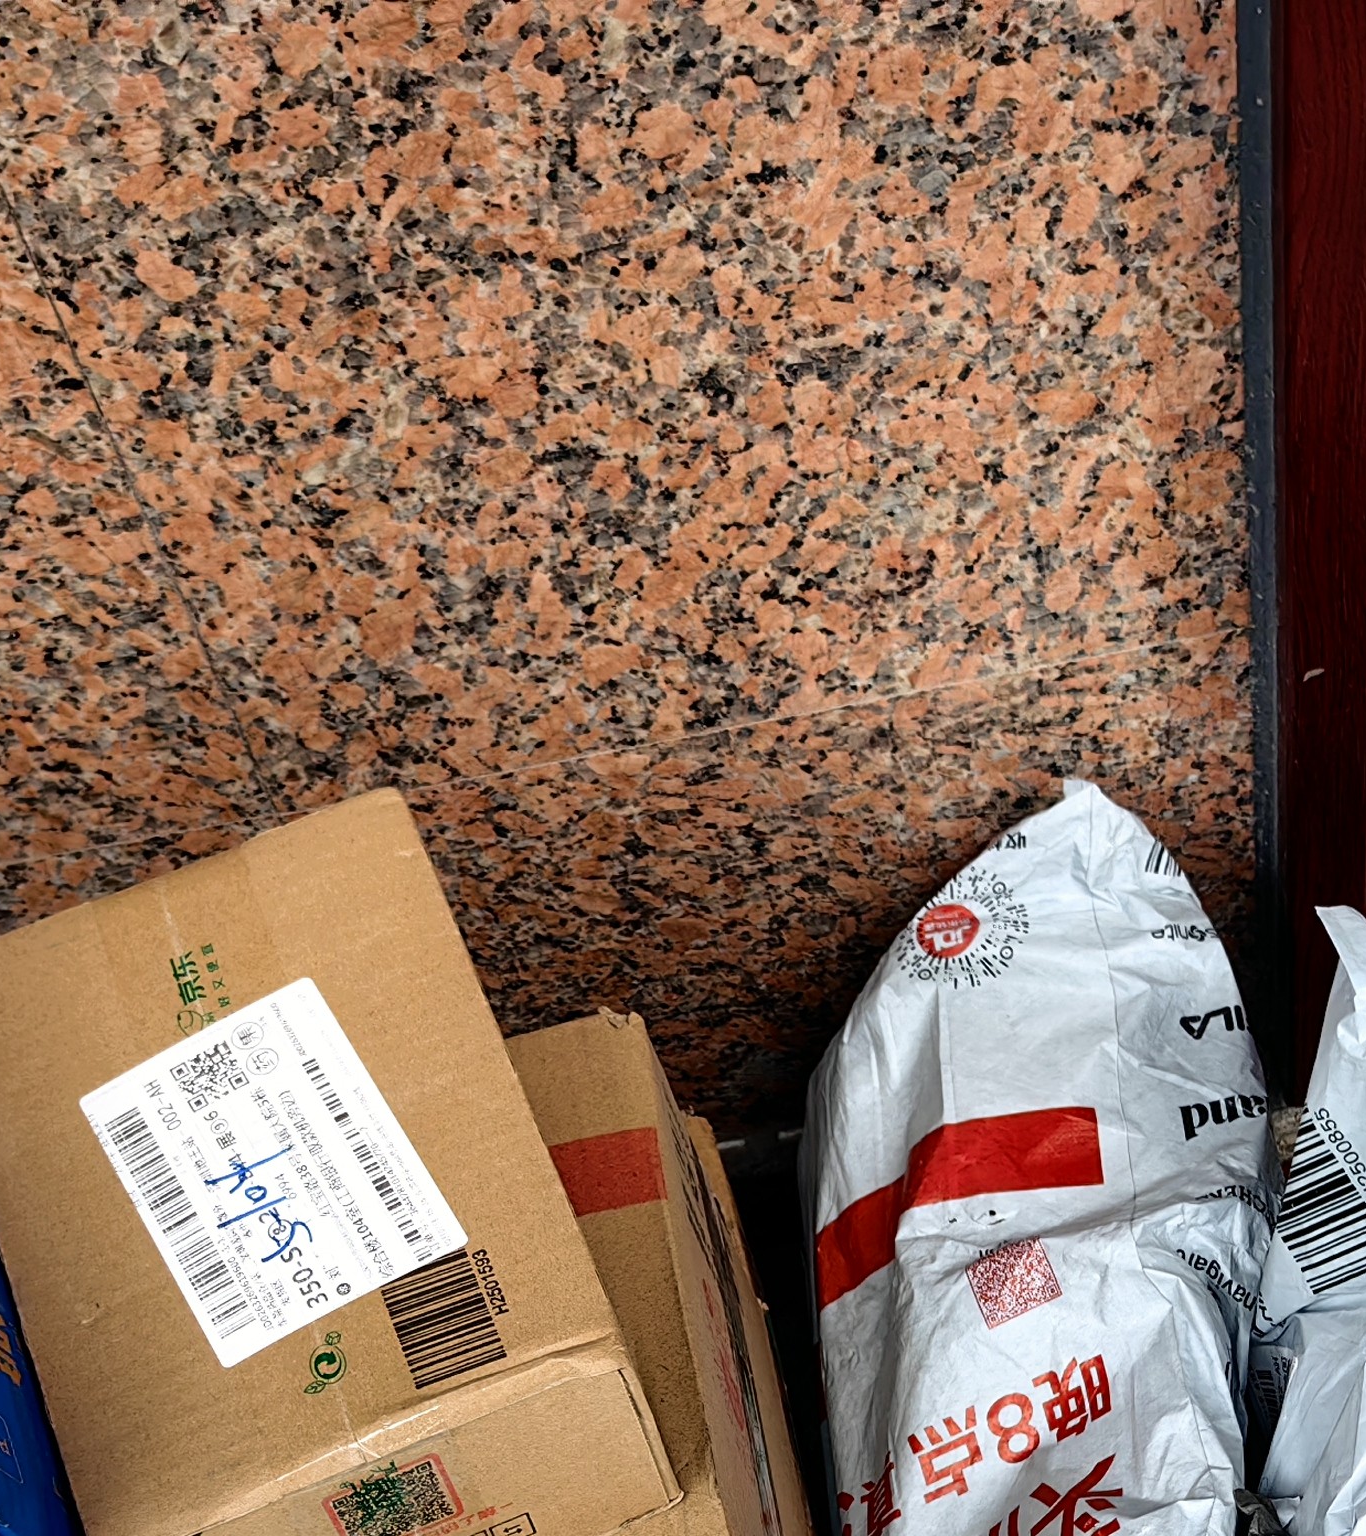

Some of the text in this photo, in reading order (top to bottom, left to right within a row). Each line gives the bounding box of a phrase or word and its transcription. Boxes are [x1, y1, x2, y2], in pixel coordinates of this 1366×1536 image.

[166, 950, 208, 1006] 京东
[471, 1248, 509, 1316] H2501593
[908, 1354, 1111, 1505] 晚8点
